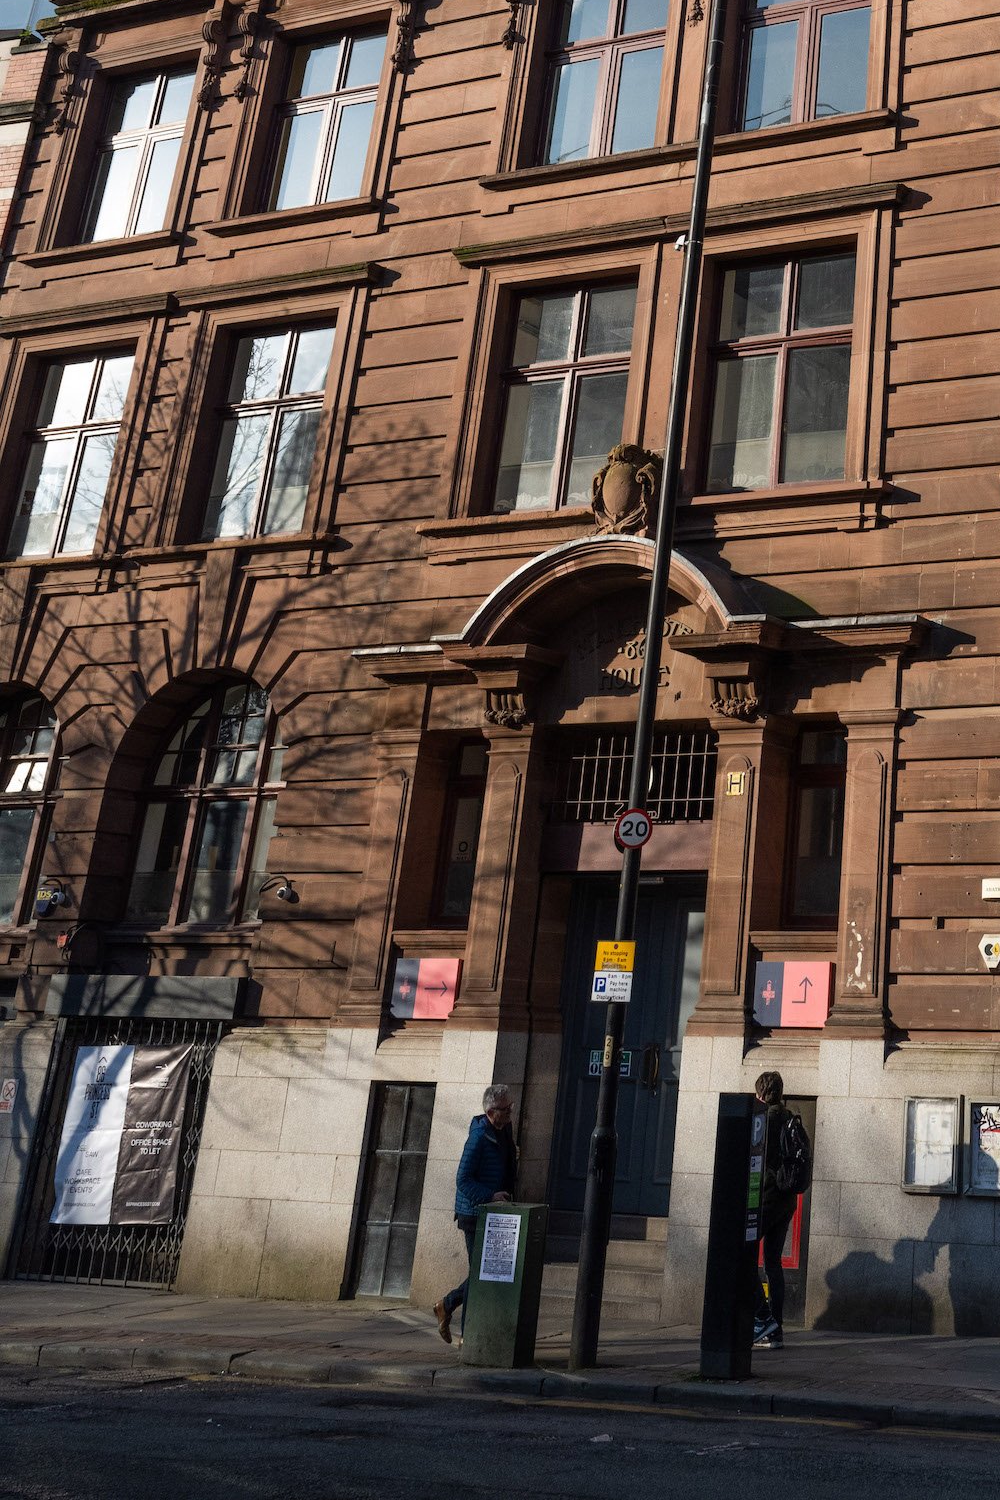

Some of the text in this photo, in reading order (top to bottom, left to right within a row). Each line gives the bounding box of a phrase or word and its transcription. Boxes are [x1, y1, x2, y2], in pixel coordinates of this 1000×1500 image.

[600, 665, 671, 690] HOUE
[622, 821, 648, 837] 20
[597, 979, 606, 992] P
[84, 1084, 113, 1101] PRINCESS
[135, 1121, 173, 1129] COWORKING
[754, 1117, 762, 1142] P
[131, 1139, 152, 1147] OFFICE
[75, 1168, 92, 1176] CAFE
[64, 1177, 101, 1185] WORKSPACE
[69, 1186, 93, 1194] EVENTS
